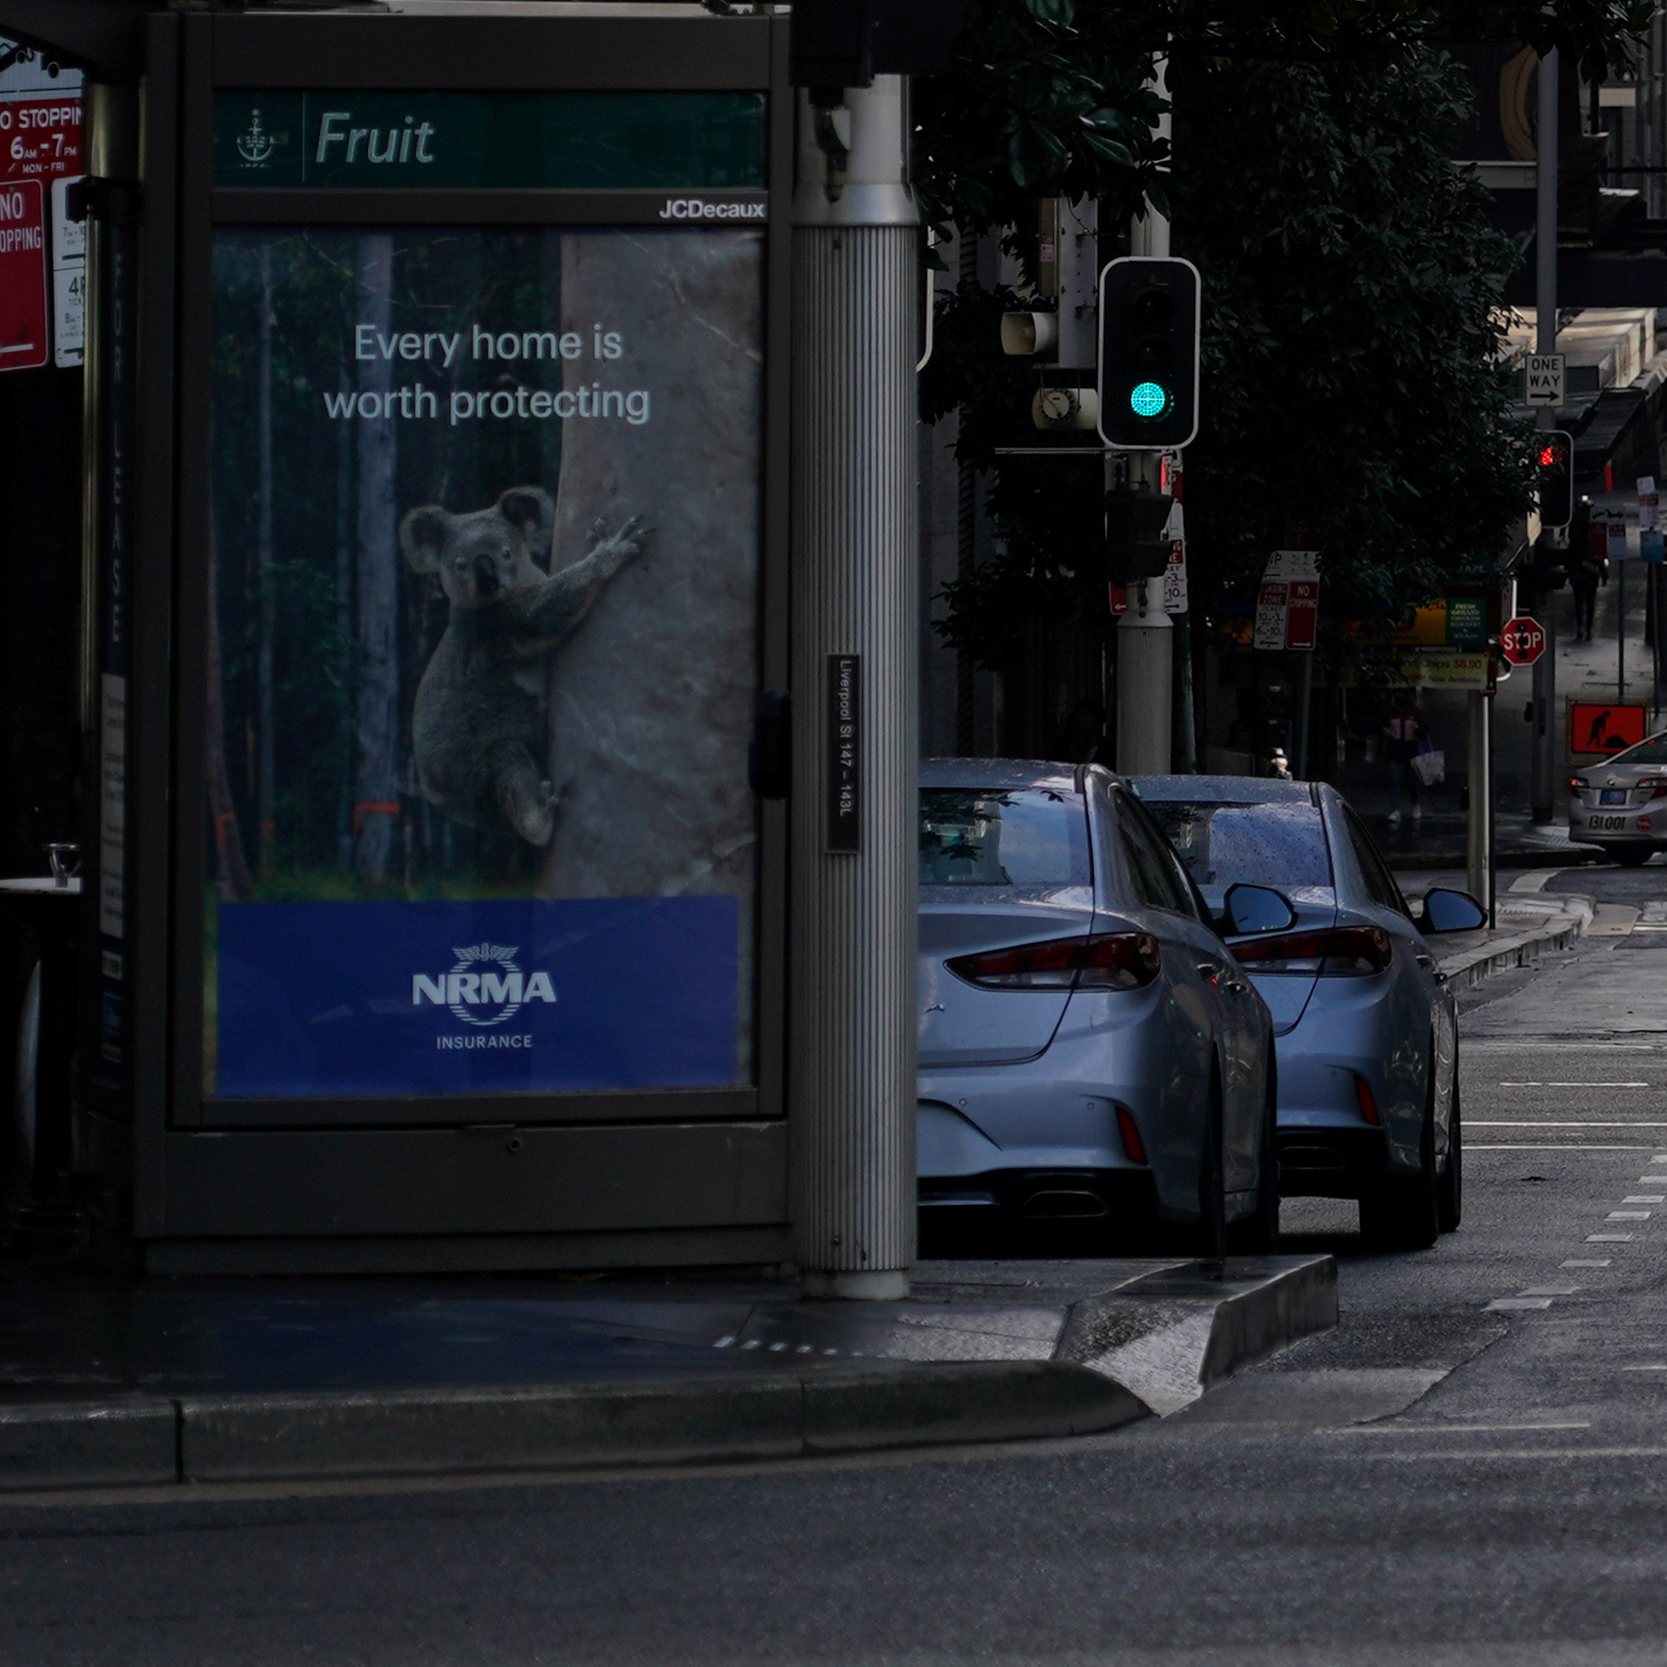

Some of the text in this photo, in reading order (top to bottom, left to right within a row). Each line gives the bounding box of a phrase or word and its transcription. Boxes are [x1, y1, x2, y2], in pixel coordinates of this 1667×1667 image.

[18, 106, 83, 129] STOPPIN
[314, 111, 436, 164] Fruit
[659, 199, 766, 219] JCDecaux
[0, 226, 42, 252] OPPING
[353, 323, 623, 368] Every home is
[1531, 358, 1560, 371] ONE
[1529, 374, 1561, 388] WAY
[322, 382, 651, 426] worth protecting
[1297, 584, 1311, 597] NO
[1503, 631, 1542, 651] STOP
[838, 660, 852, 721] Liverpool
[839, 724, 852, 739] St
[839, 742, 852, 768] 147
[838, 784, 852, 817] 143L
[1605, 816, 1627, 830] 001
[411, 971, 558, 1005] NRMA
[436, 1034, 534, 1050] INSURANCE
